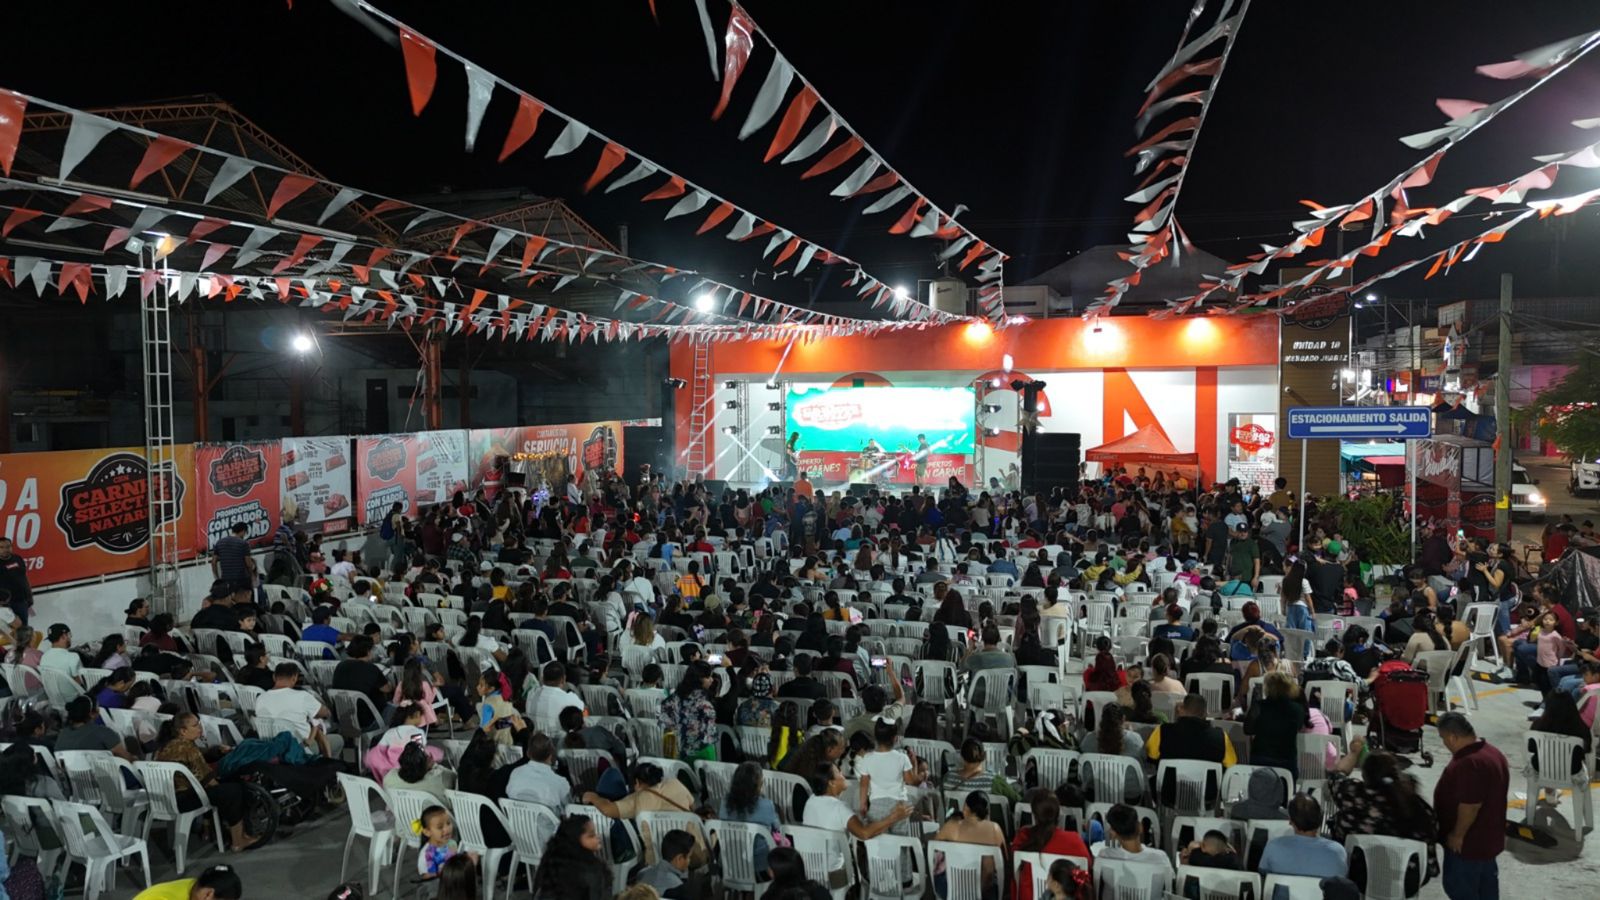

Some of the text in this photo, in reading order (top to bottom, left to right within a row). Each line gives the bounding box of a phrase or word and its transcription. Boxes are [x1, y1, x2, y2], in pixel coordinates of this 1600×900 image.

[1293, 341, 1327, 350] UNIDAD
[1291, 412, 1427, 424] ESTACIONAMIENTO SALIDA
[523, 438, 569, 453] SERVICIO
[570, 437, 577, 454] A
[15, 477, 39, 511] A
[366, 498, 381, 510] CON
[209, 517, 229, 533] CON
[231, 509, 262, 527] SABOR
